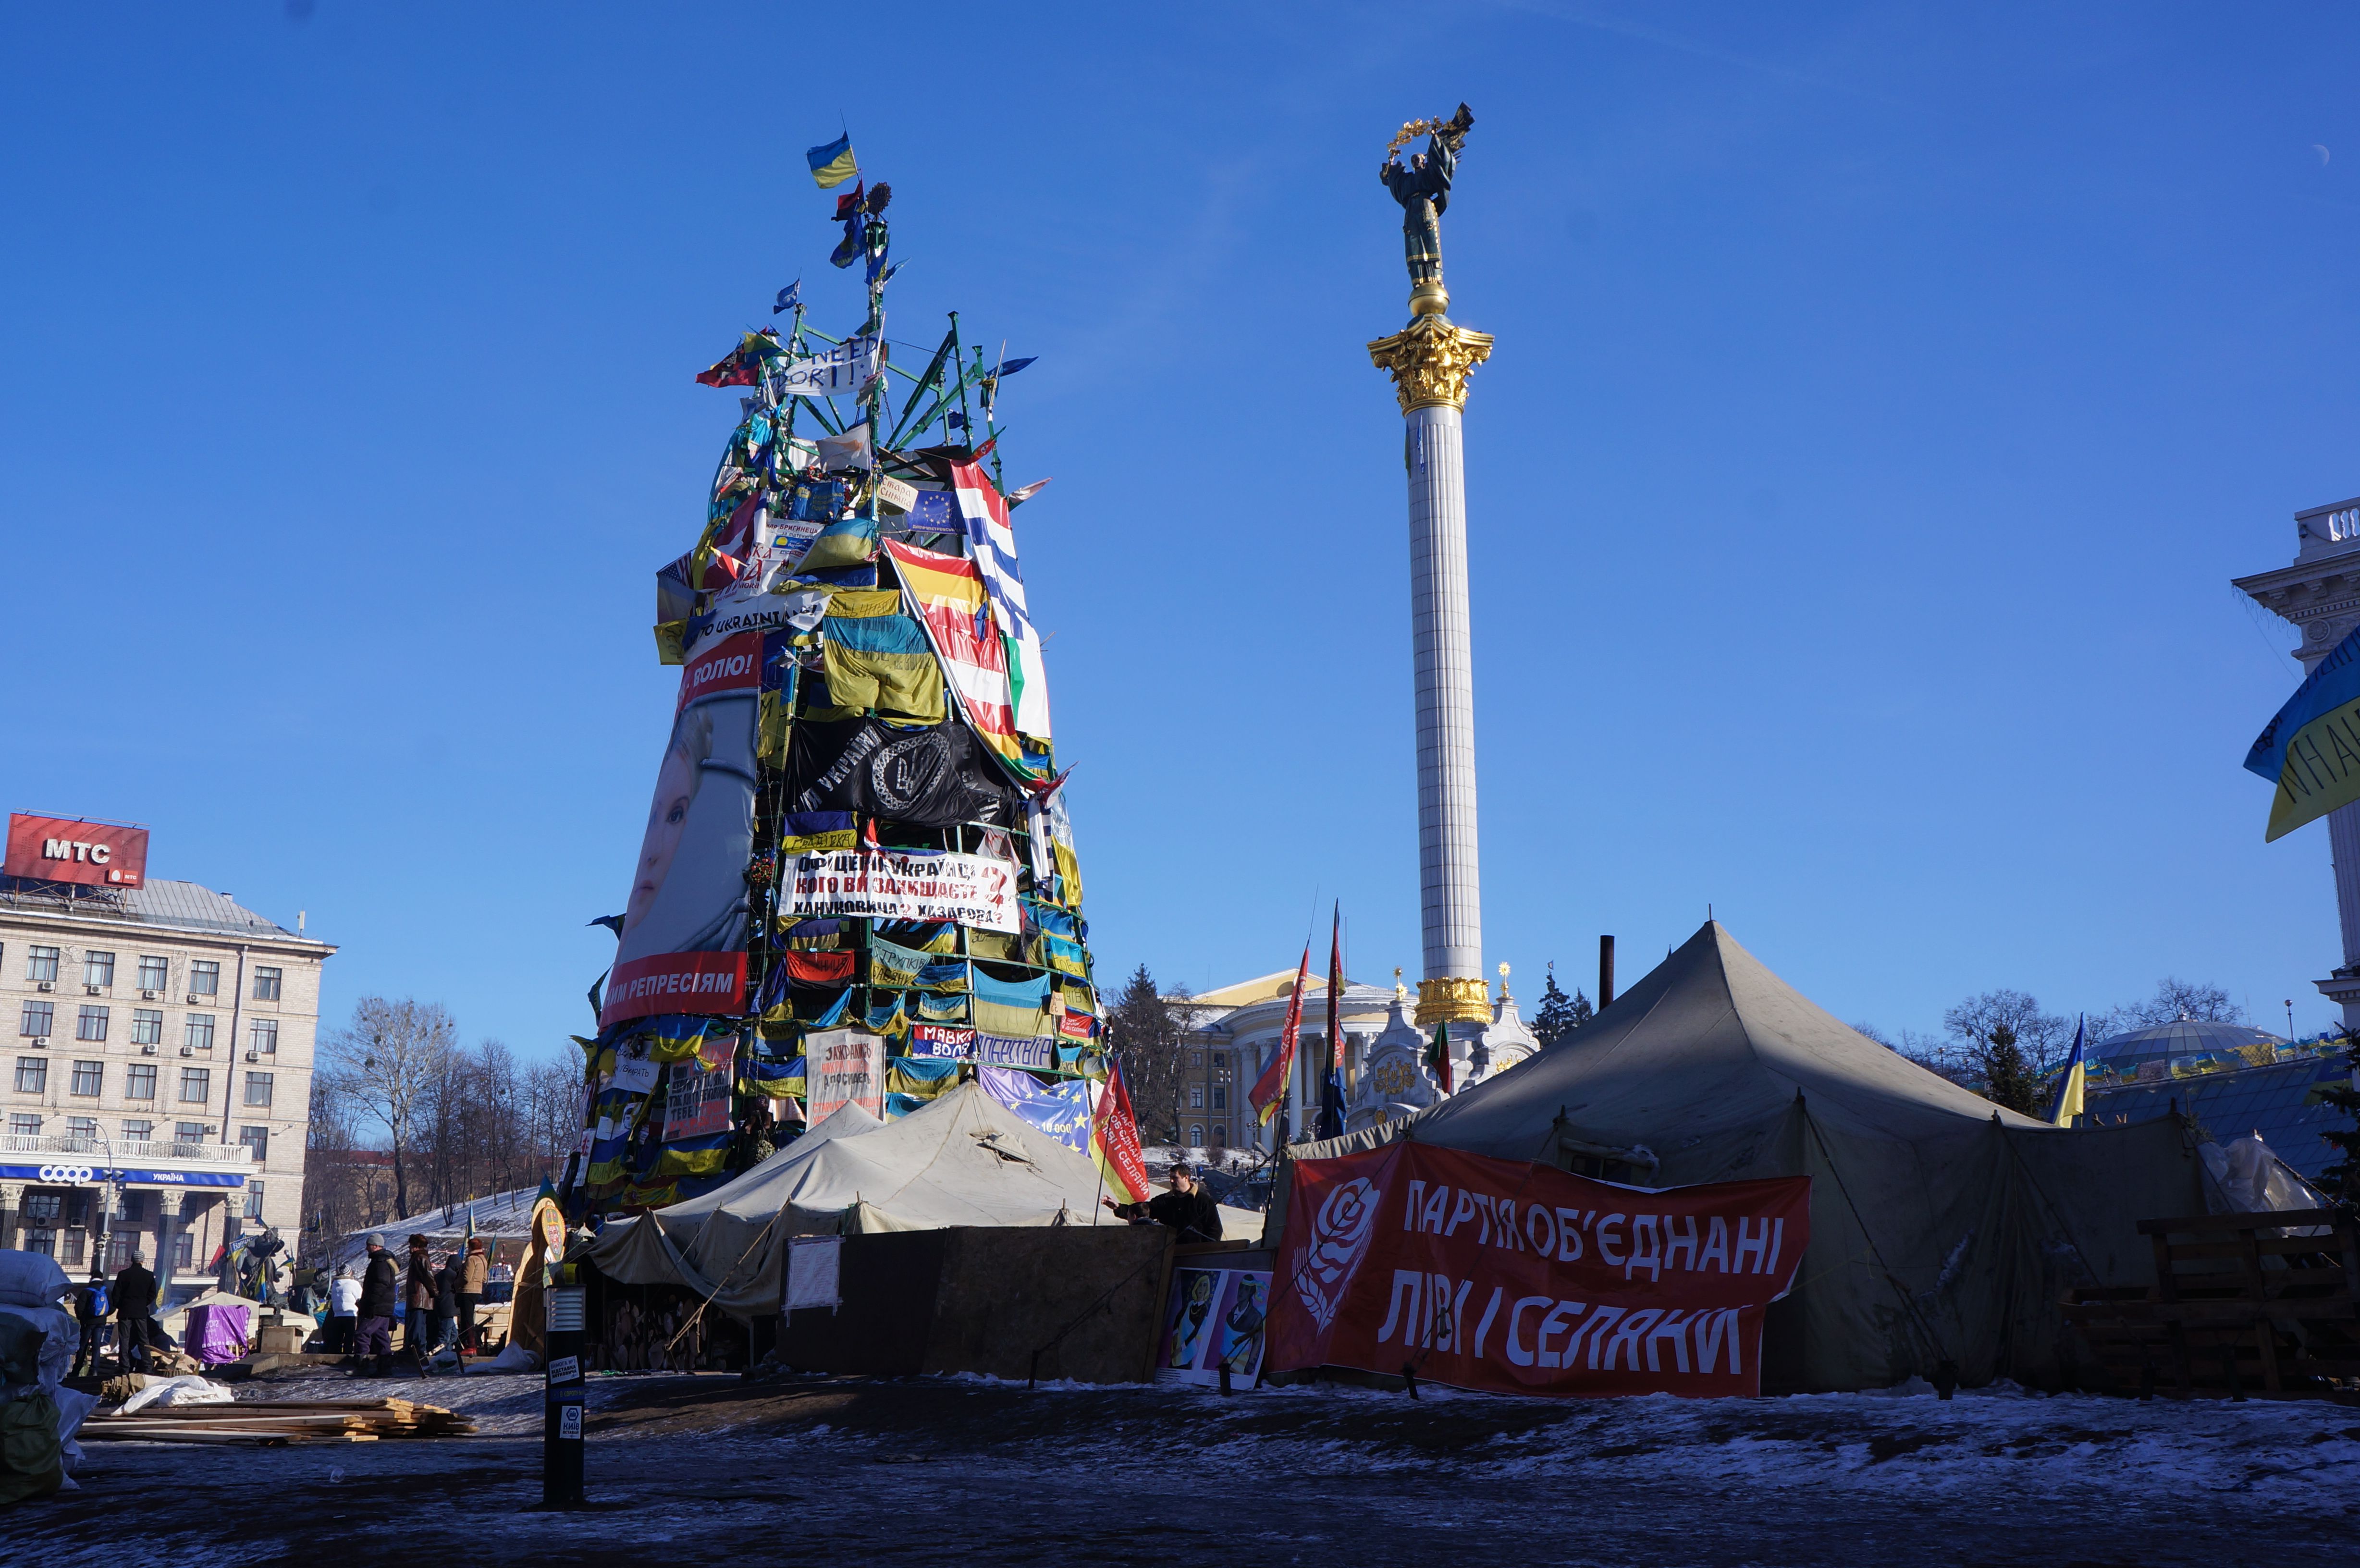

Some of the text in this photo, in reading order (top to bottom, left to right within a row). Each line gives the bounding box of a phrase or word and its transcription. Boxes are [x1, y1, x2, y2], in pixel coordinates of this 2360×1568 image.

[693, 654, 753, 687] ВОЛЮ!
[46, 838, 111, 863] МТС
[796, 877, 838, 894] КОГО
[843, 877, 868, 894] ВИ
[628, 973, 734, 999] РЕПРЕСІЯМ
[671, 1106, 693, 1121] ТЕБЕ
[153, 1172, 184, 1182] УКРАЇНА
[1119, 1151, 1150, 1195] СЕЛЯНИ
[1404, 1179, 1784, 1283] ПАРТІЯ ОБ'ЄДНАНІ
[1378, 1269, 1753, 1375] ЛІВІ І СЕЛЯНИ
[563, 1421, 579, 1430] КИЇВ
